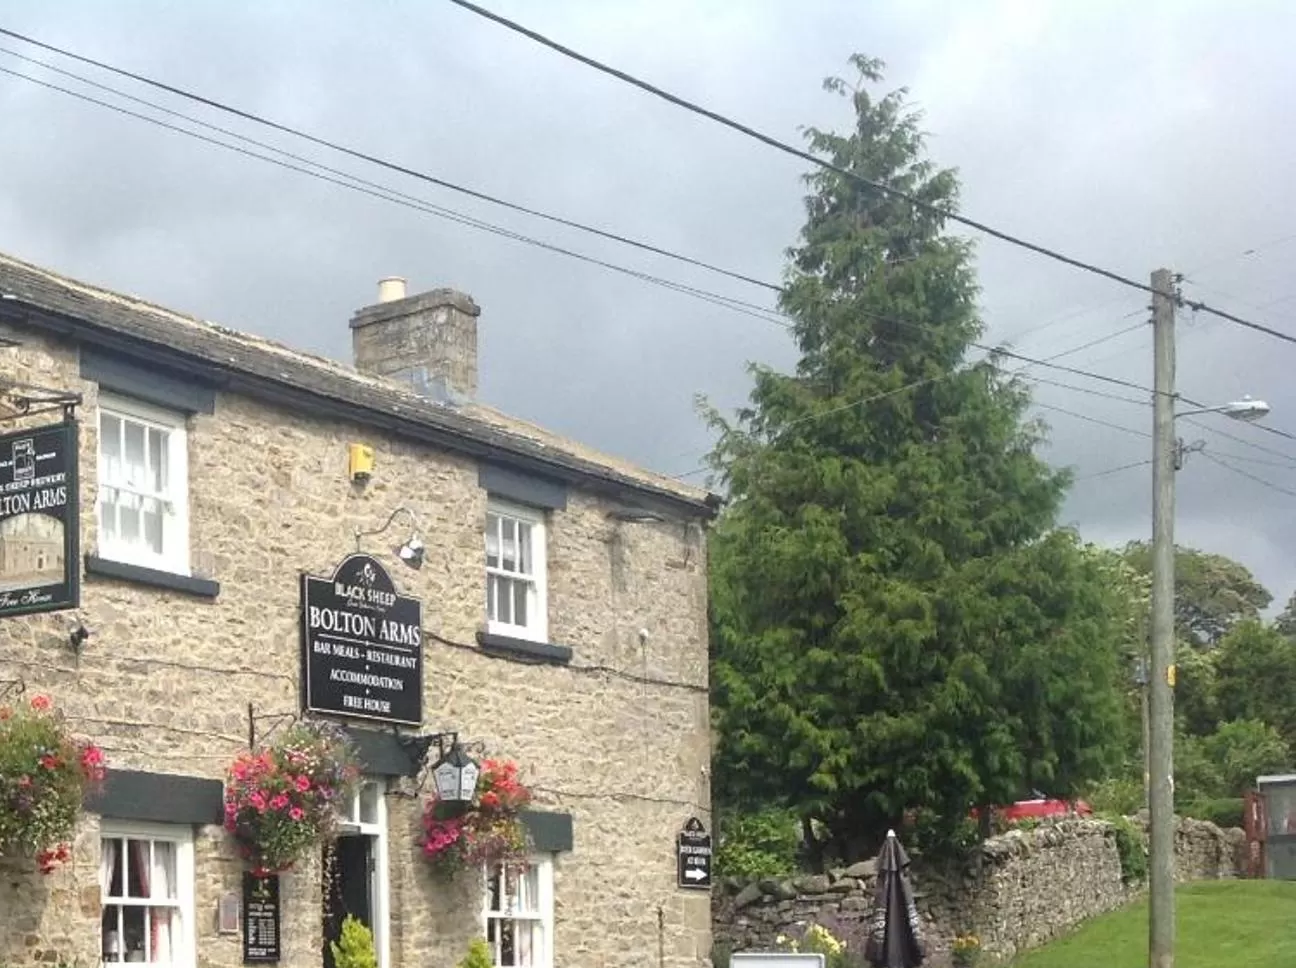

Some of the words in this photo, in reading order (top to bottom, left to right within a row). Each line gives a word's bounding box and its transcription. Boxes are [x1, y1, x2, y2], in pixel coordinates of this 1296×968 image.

[32, 486, 67, 510] ARMS
[335, 581, 366, 601] BLACK
[367, 589, 396, 607] SHEEP
[309, 605, 376, 638] BOLTON
[379, 619, 421, 647] ARMS
[313, 640, 331, 655] BAR
[332, 643, 360, 659] MEALS
[366, 649, 418, 669] RESTAURANT
[329, 668, 404, 691] ACCOMMODATION
[343, 695, 364, 710] FREE
[364, 697, 391, 713] HOUSE
